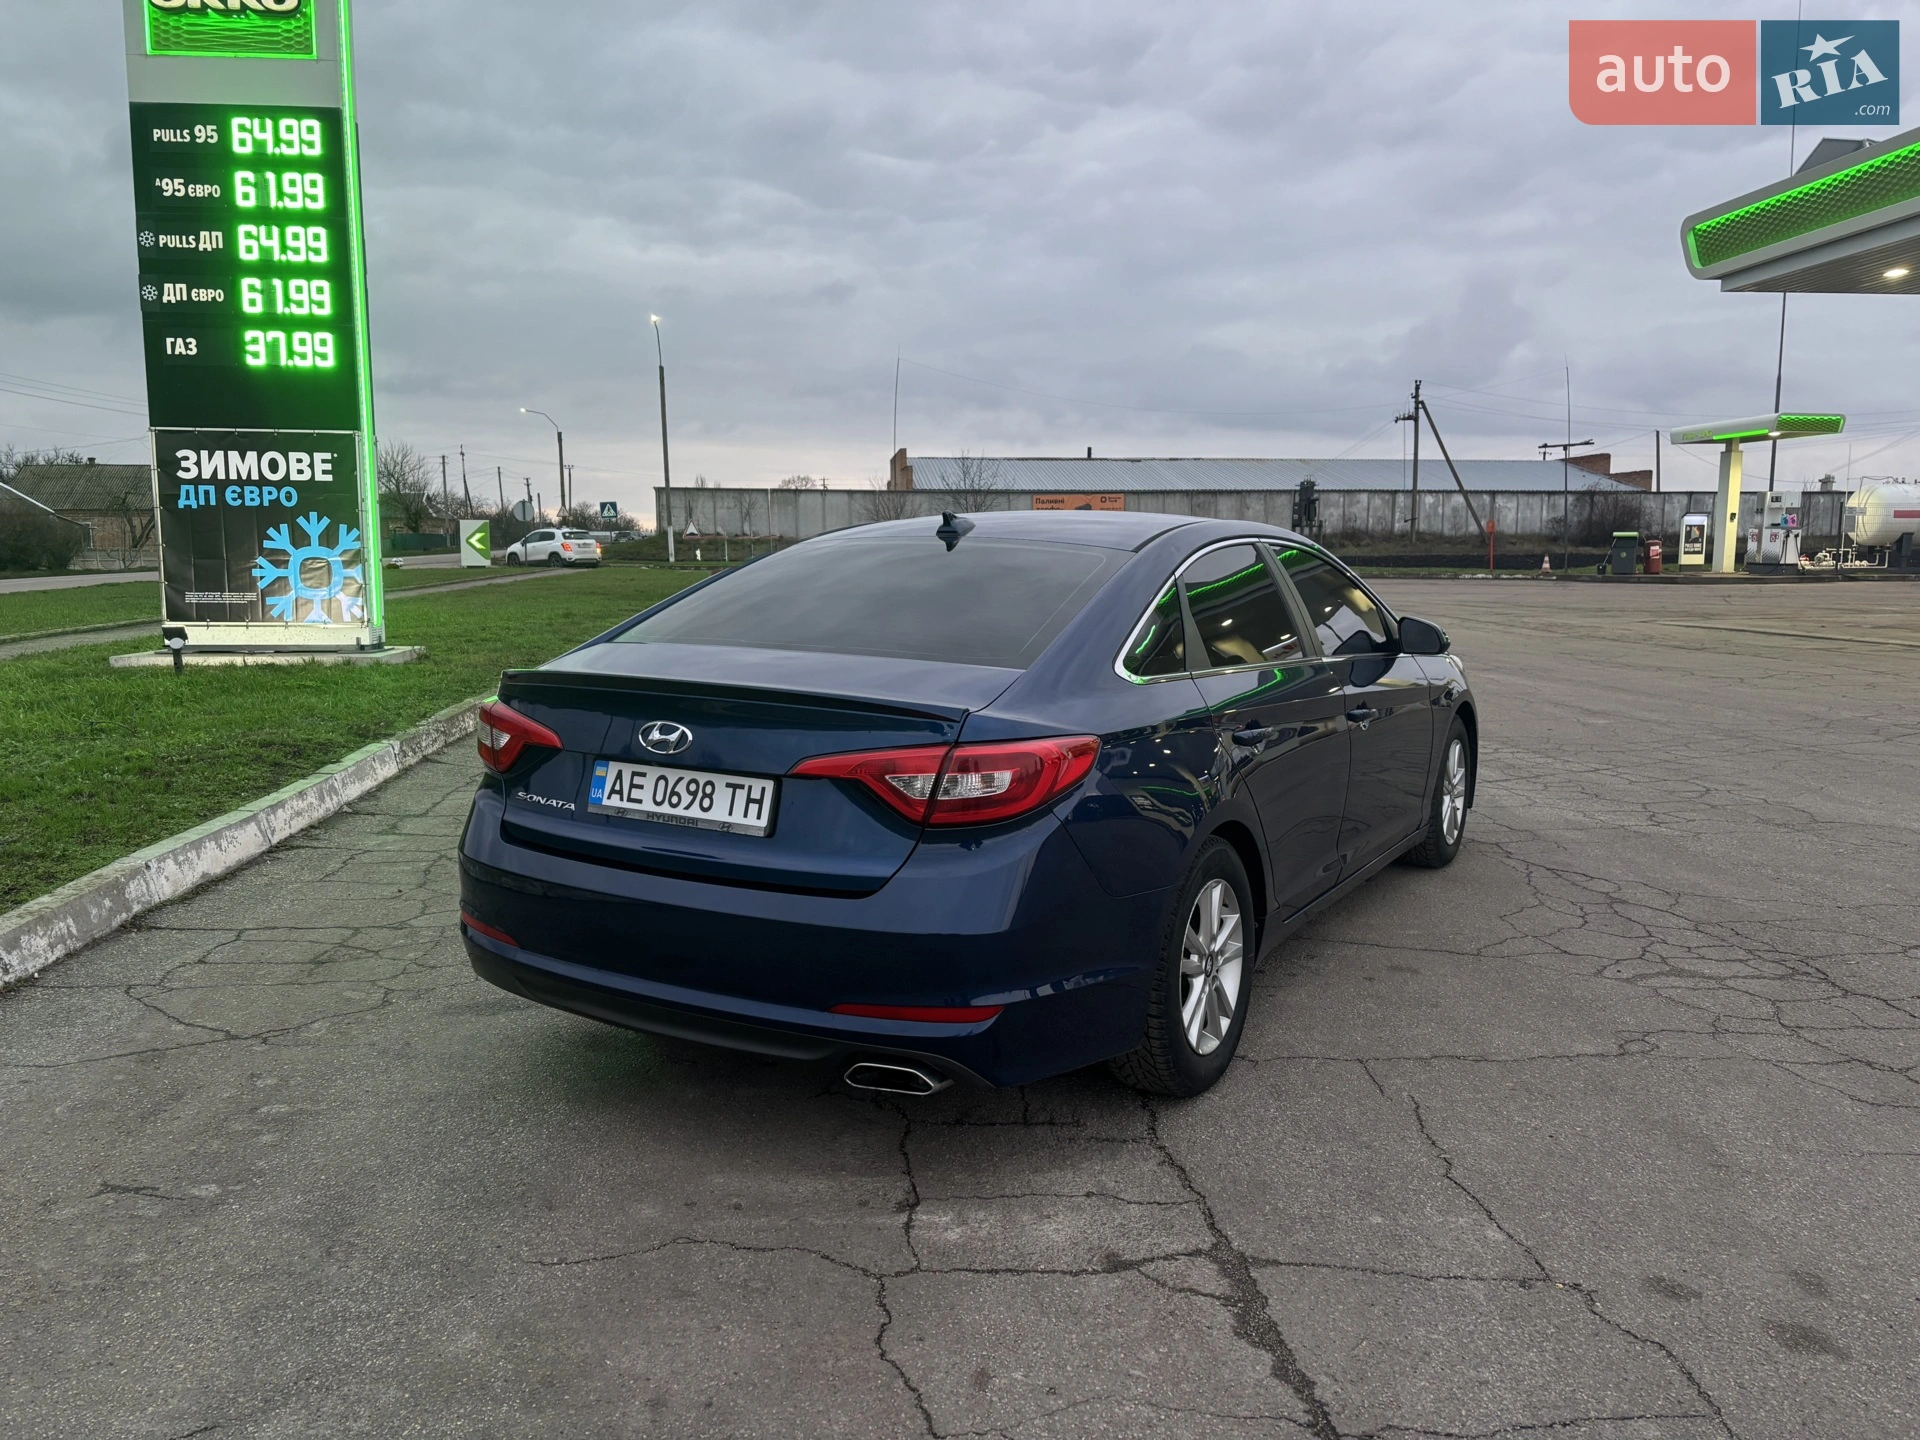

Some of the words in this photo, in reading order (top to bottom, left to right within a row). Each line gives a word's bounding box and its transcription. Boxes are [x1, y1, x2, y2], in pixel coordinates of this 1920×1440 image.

[153, 128, 191, 143] PULLS
[194, 124, 218, 143] 95
[231, 117, 321, 156] 64.99
[187, 184, 221, 198] ЄВРО
[234, 171, 325, 209] 61.99
[158, 234, 196, 248] PULLS
[198, 231, 223, 251] ДП
[237, 224, 328, 262] 64.99
[162, 283, 187, 303] ДП
[241, 277, 331, 316] 61.99
[165, 337, 198, 355] ГАЗ
[244, 330, 335, 368] 37.99
[175, 449, 333, 482] ЗИМОВЕ
[178, 484, 217, 509] ДП
[225, 485, 298, 508] ЄВРО
[516, 791, 575, 811] SONATA
[591, 787, 603, 799] UA
[606, 769, 647, 804] AE
[652, 774, 716, 813] 0698
[725, 782, 767, 821] TH
[646, 813, 699, 827] HYUNDAI
